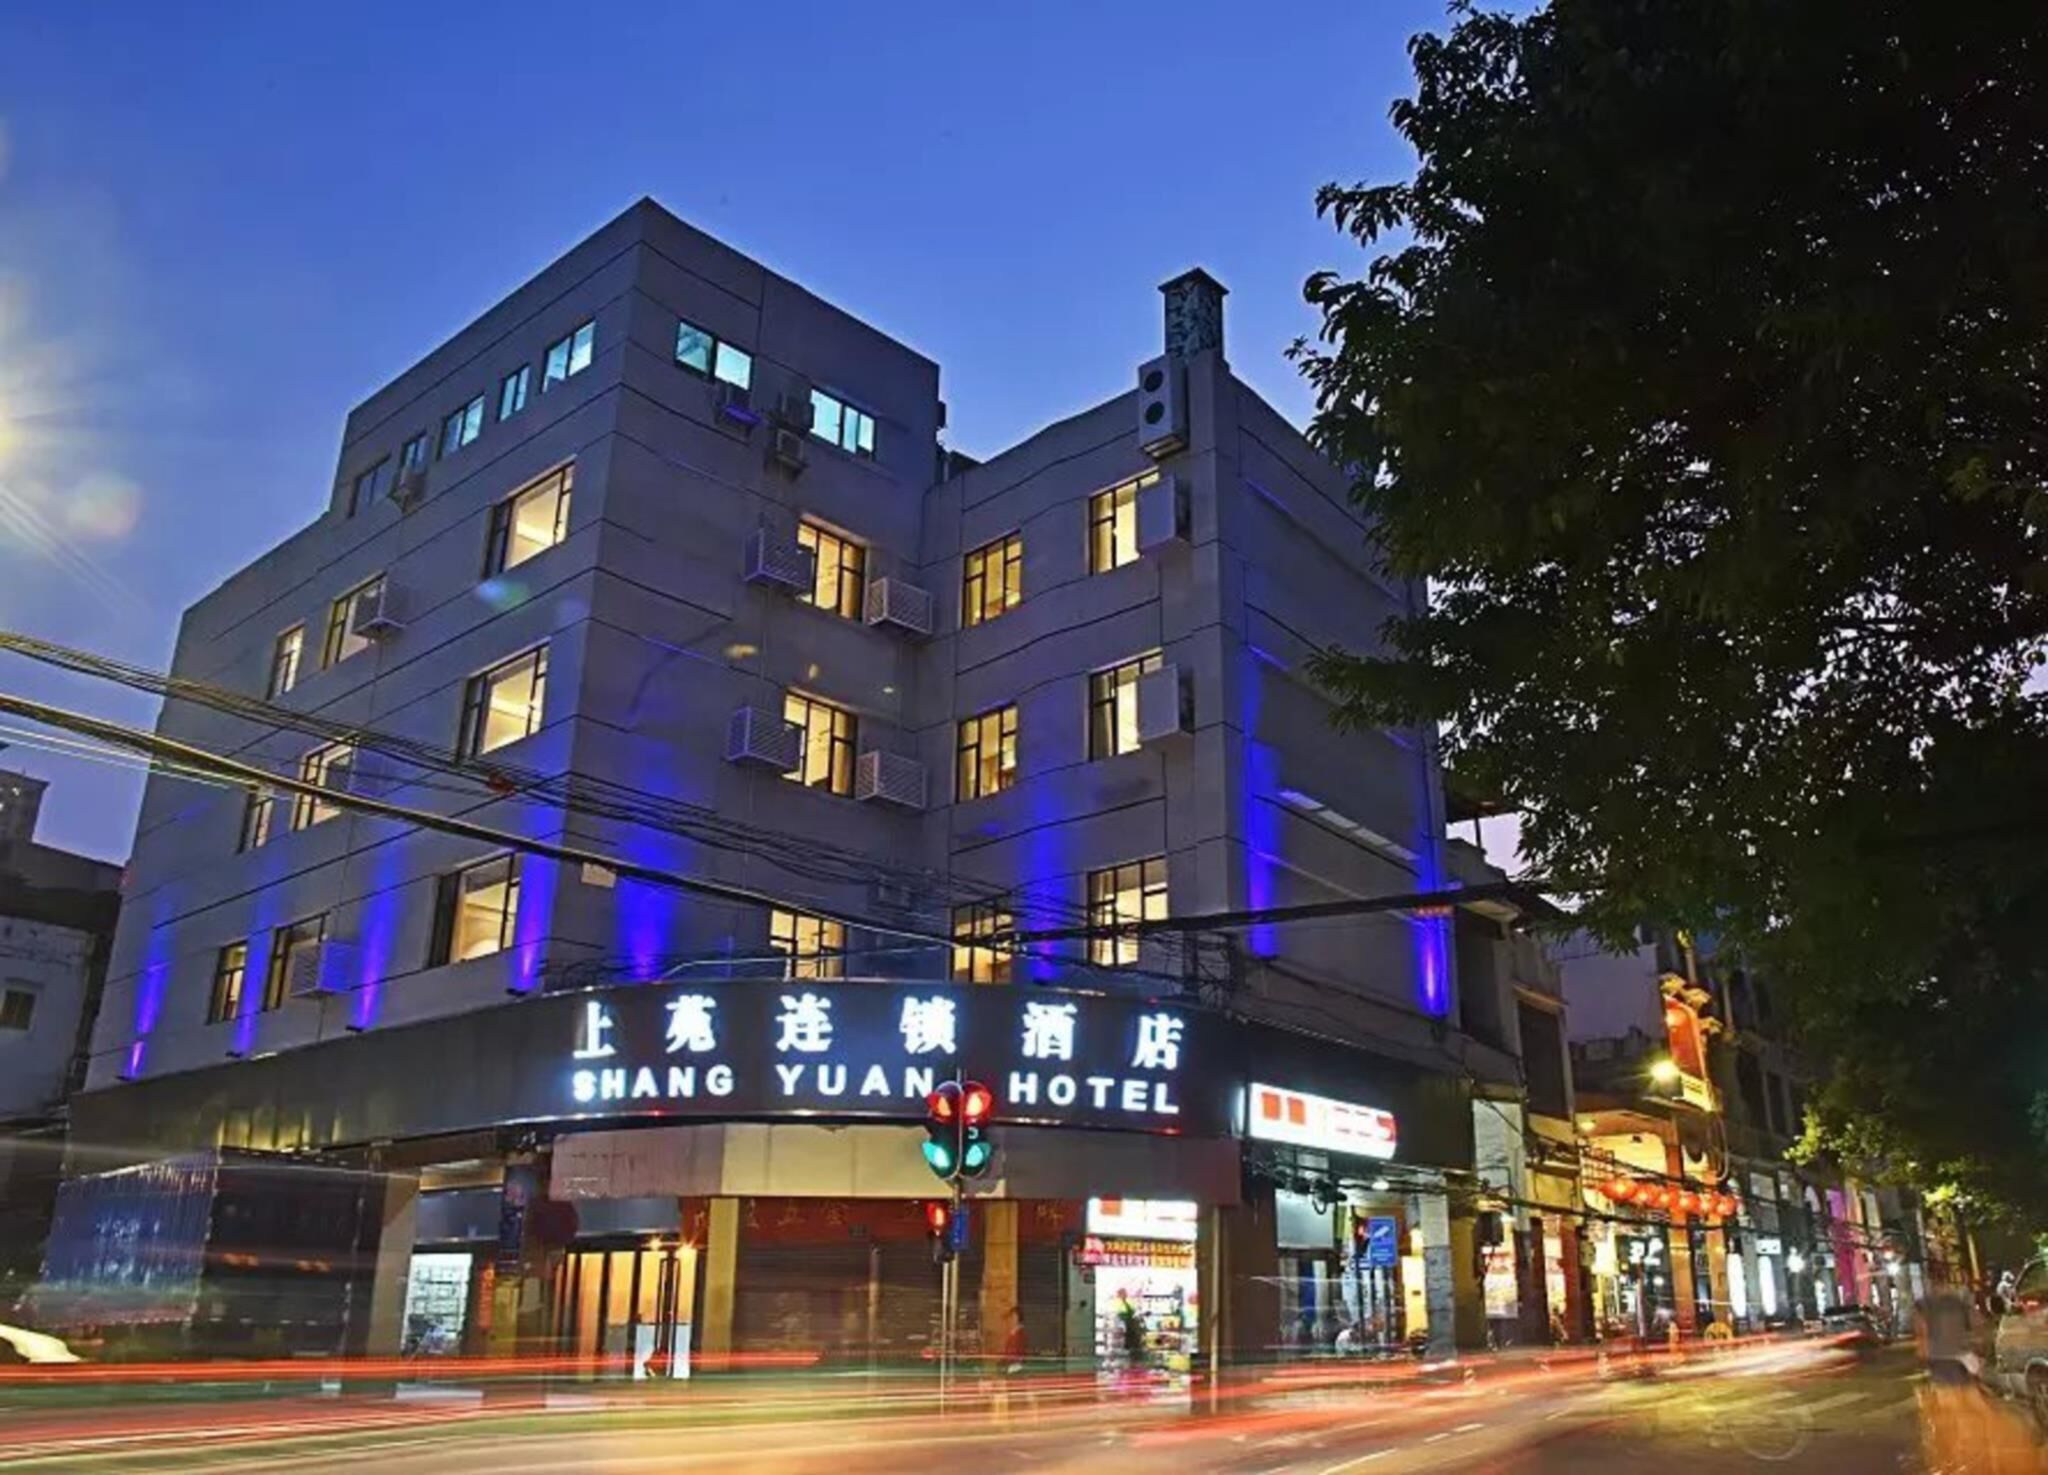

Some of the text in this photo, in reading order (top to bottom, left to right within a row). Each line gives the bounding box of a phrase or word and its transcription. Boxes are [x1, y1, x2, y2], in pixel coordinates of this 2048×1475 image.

[572, 993, 1186, 1070] 上苑连锁酒店
[572, 1064, 1180, 1114] SHANG YUAN HOTEL
